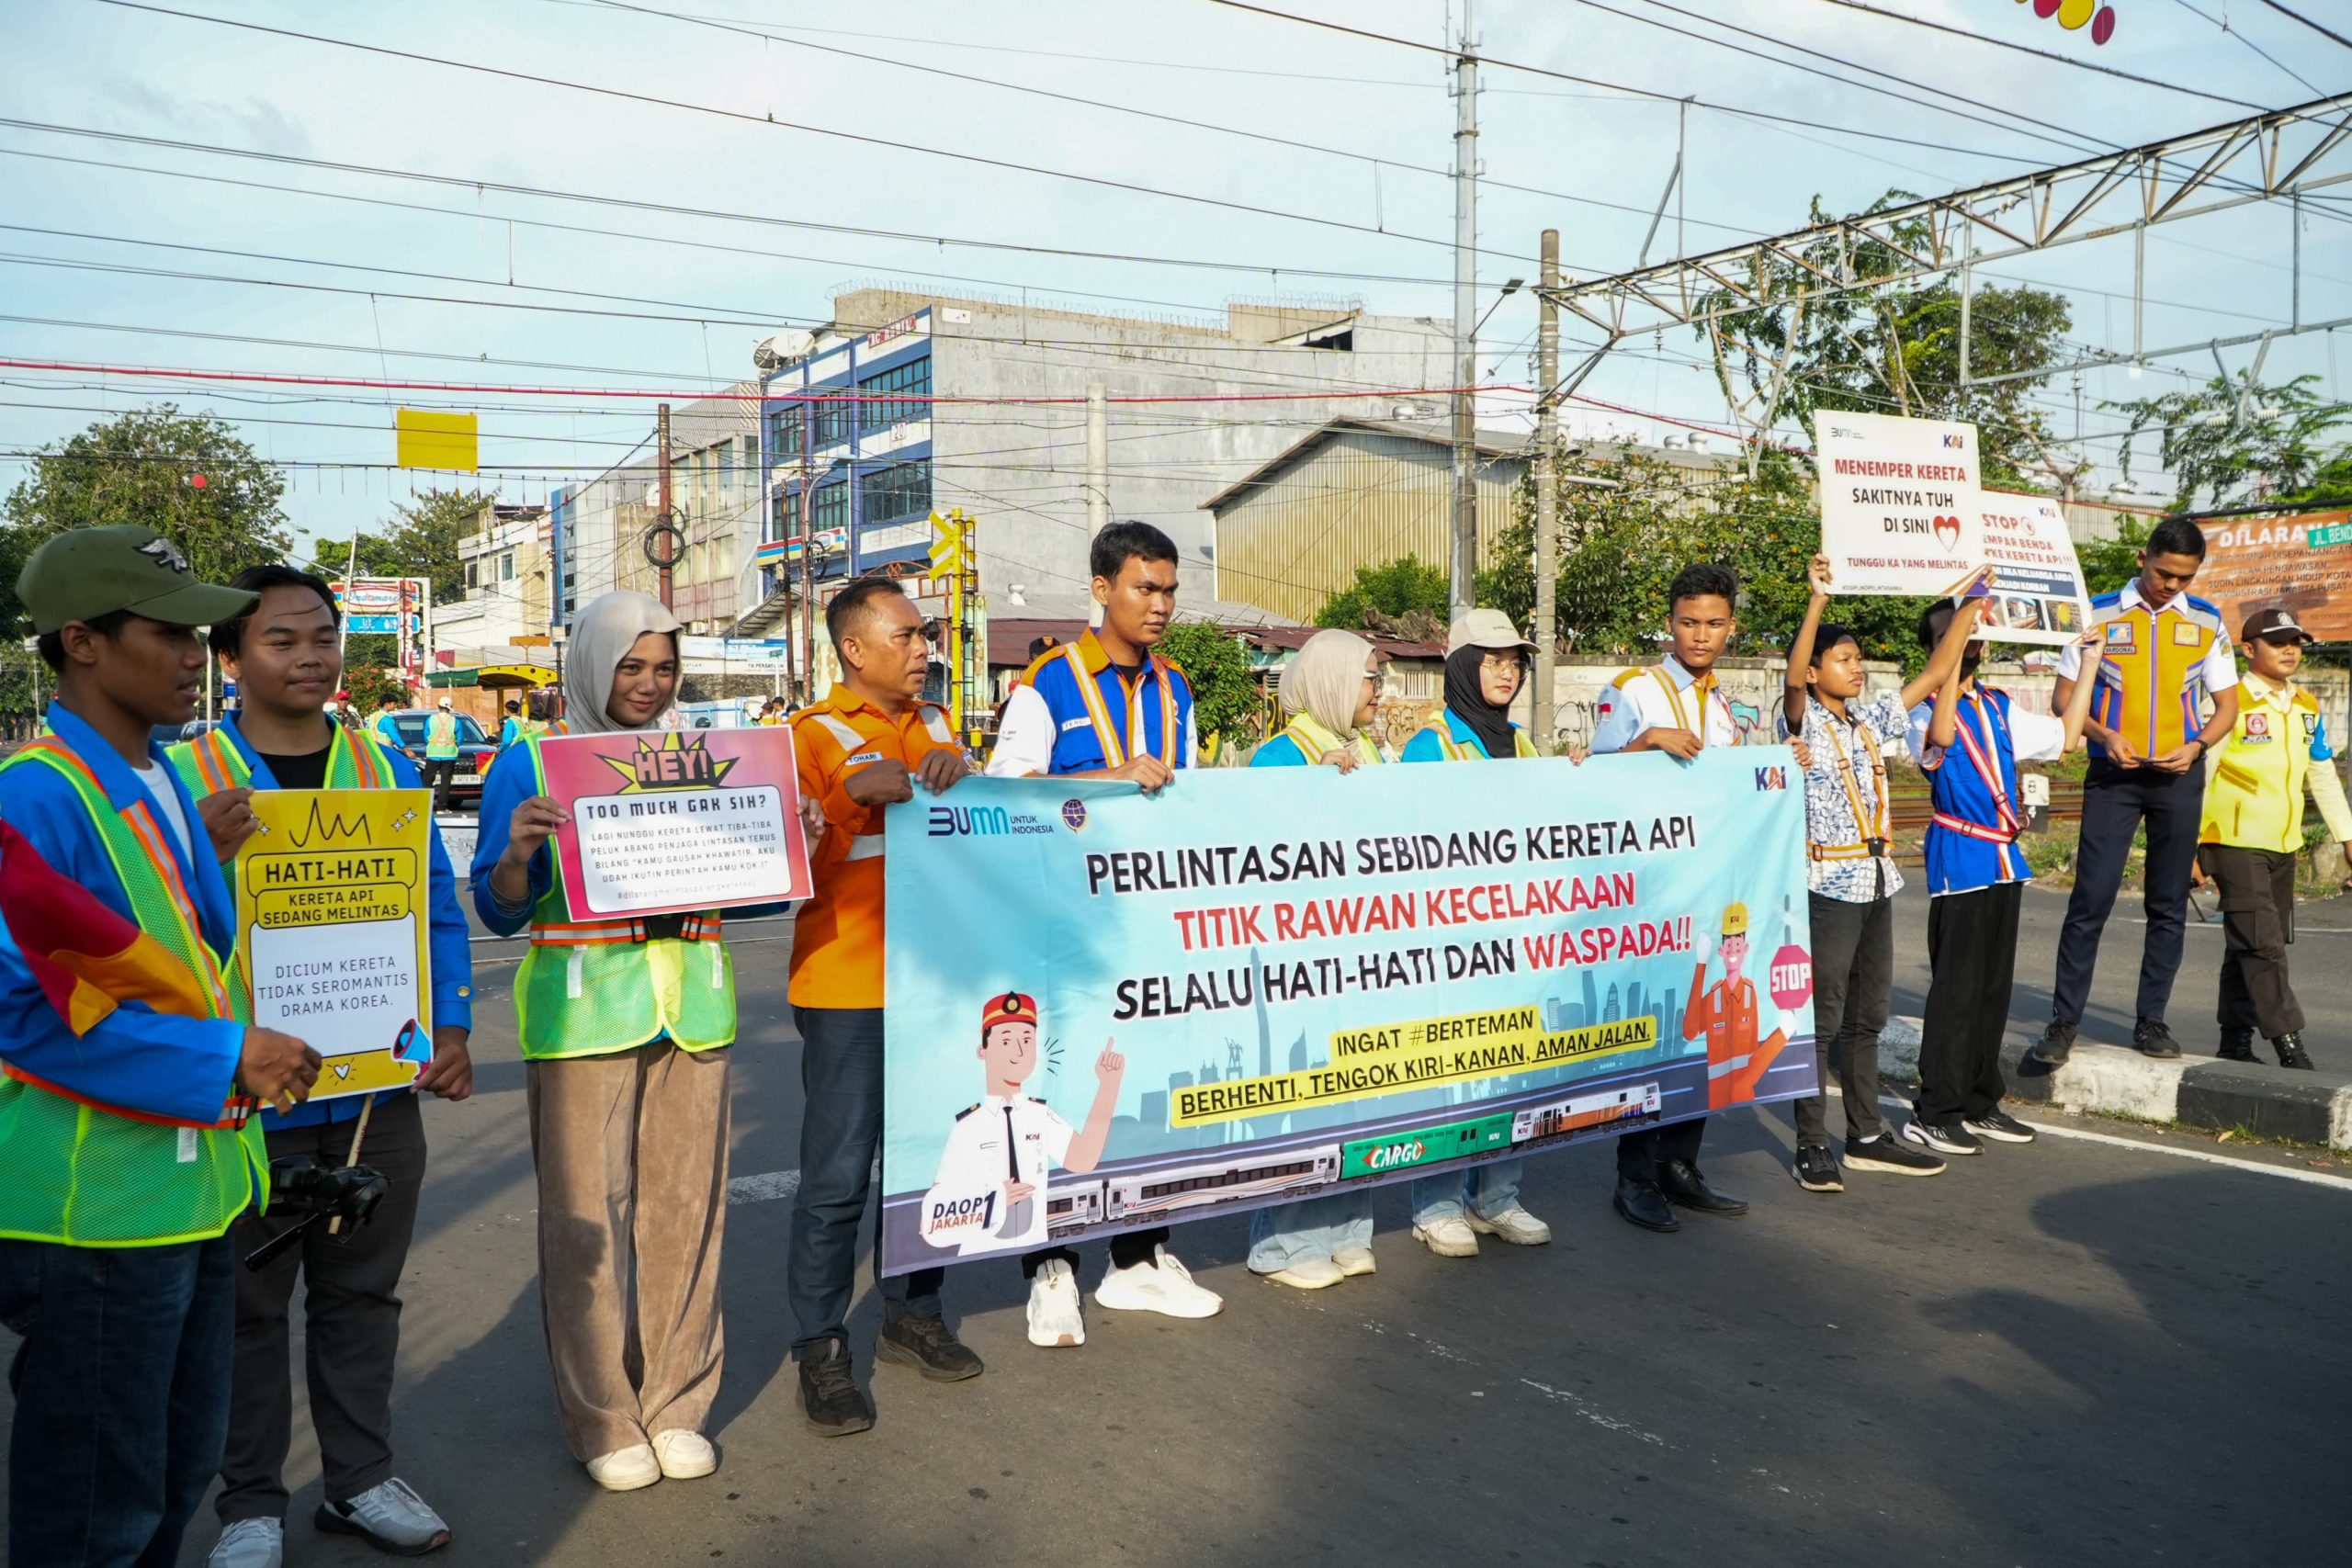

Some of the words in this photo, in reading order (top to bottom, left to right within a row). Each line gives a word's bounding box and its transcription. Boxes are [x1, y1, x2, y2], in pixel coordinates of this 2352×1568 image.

[1943, 434, 1963, 449] KAI
[1835, 458, 1913, 479] MENEMPER
[1917, 464, 1966, 482] KERETA
[1852, 488, 1922, 506] SAKITNYA
[1926, 491, 1953, 508] TUH
[1883, 517, 1898, 533] DI
[1903, 518, 1929, 534] SINI
[1982, 513, 2018, 531] STOP
[2019, 537, 2053, 551] BENDA
[2272, 547, 2338, 559] DISEPANJANG
[1847, 558, 1884, 568] TUNGGU
[1888, 558, 1899, 568] KA
[1902, 558, 1926, 569] YANG
[1928, 559, 1968, 570] MELINTAS
[2006, 549, 2044, 564] KERETA
[2263, 561, 2327, 574] PENGAWASAN
[2208, 579, 2234, 588] SUDIN
[2235, 575, 2293, 587] LINGKUNGAN
[2297, 571, 2323, 582] HIDUP
[2326, 571, 2352, 581] KOTA
[2274, 584, 2315, 596] JAKARTA
[2318, 581, 2347, 592] PUSAT
[633, 749, 713, 785] HEY!
[849, 753, 877, 763] TOHARI
[1755, 765, 1787, 791] KAI
[586, 805, 619, 819] TOO
[629, 801, 678, 817] MUCH
[687, 797, 721, 813] GAK
[729, 795, 766, 809] SIH?
[591, 832, 614, 841] LAGI
[616, 829, 654, 840] NUNGGU
[658, 827, 691, 837] KERETA
[695, 824, 724, 834] LEWAT
[728, 820, 772, 831] TIBA-TIBA
[1010, 816, 1037, 824] UNTUK
[1012, 825, 1055, 834] INDONESIA
[591, 846, 619, 856] PELUK
[625, 843, 654, 853] ABANG
[658, 840, 698, 851] PENJAGA
[702, 836, 745, 846] LINTASAN
[749, 833, 776, 843] TERUS
[1086, 840, 1346, 896] PERLINTASAN
[1356, 829, 1518, 874] SEBIDANG
[1526, 819, 1641, 862] KERETA
[1649, 816, 1695, 851] API
[595, 859, 628, 870] BILANG
[666, 853, 701, 864] GAUSAH
[758, 846, 775, 855] AKU
[266, 858, 395, 884] HATI-HATI
[602, 874, 628, 883] UDAH
[631, 870, 662, 880] IKUTIN
[665, 866, 708, 877] PERINTAH
[712, 863, 737, 873] KAMU
[740, 862, 757, 871] KOK
[289, 891, 345, 907] KERETA
[349, 890, 374, 902] API
[264, 908, 322, 925] SEDANG
[327, 904, 400, 919] MELINTAS
[1173, 905, 1269, 951] TITIK
[1273, 892, 1416, 942] RAWAN
[1425, 872, 1635, 927] KECELAKAAN
[276, 962, 333, 979] DICIUM
[340, 956, 396, 972] KERETA
[1113, 967, 1252, 1021] SELALU
[1263, 948, 1434, 1003] HATI-HATI
[1444, 938, 1516, 980] DAN
[1523, 916, 1691, 970] WASPADA!!
[1770, 963, 1812, 993] STOP
[258, 984, 305, 999] TIDAK
[311, 974, 408, 995] SEROMANTIS
[281, 1001, 334, 1018] DRAMA
[341, 995, 393, 1010] KOREA.
[1337, 1029, 1401, 1057] INGAT
[1408, 1010, 1533, 1046] #BERTEMAN
[1181, 1077, 1303, 1116] BERHENTI,
[1309, 1063, 1399, 1095] TENGOK
[1405, 1043, 1531, 1080] KIRI-KANAN,
[1536, 1032, 1589, 1059] AMAN
[1594, 1021, 1650, 1048] JALAN.
[1370, 1141, 1423, 1169] CARGO
[933, 1197, 983, 1220] DAOP
[982, 1190, 997, 1230] 1
[928, 1212, 983, 1235] JAKARTA
